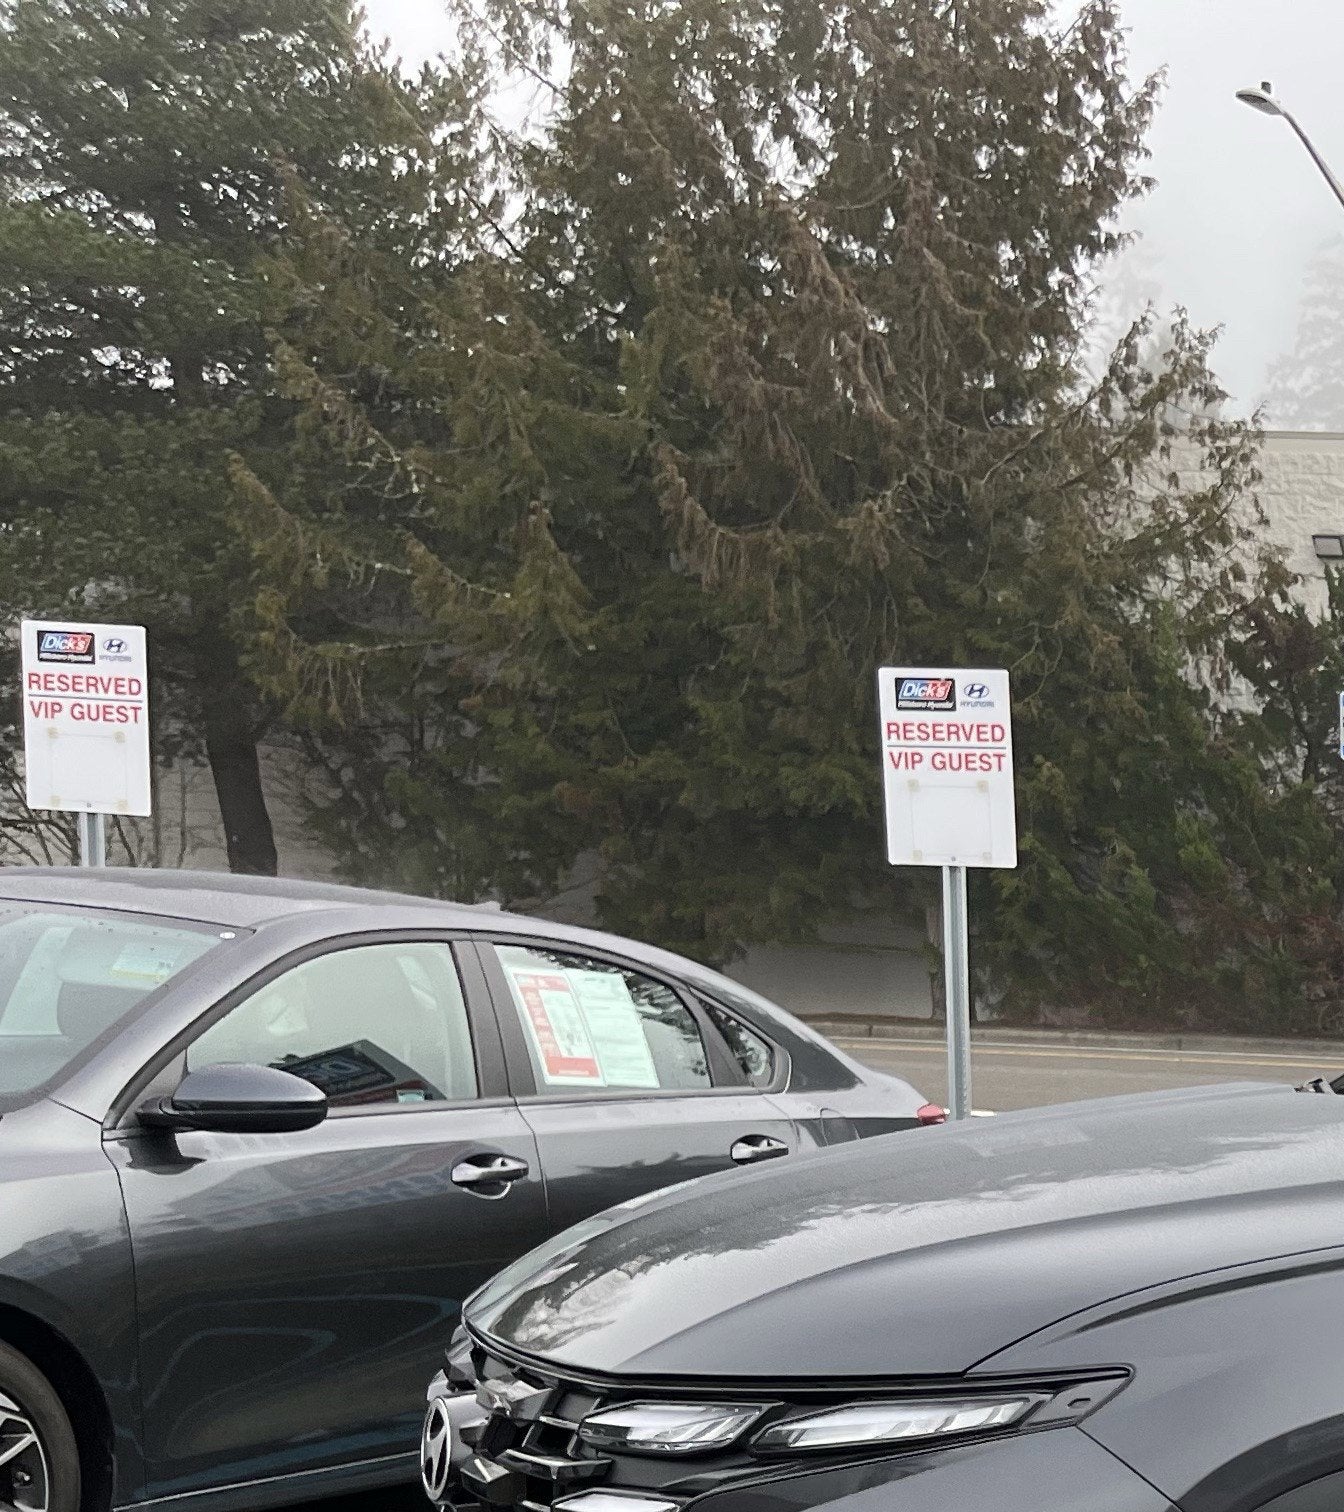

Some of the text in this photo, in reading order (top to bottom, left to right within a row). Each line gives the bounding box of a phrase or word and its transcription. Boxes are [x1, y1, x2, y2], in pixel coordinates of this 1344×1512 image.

[27, 672, 142, 696] RESERVED
[30, 700, 143, 724] VIP GUEST
[886, 721, 1006, 743] RESERVED
[889, 751, 1006, 772] VIP GUEST
